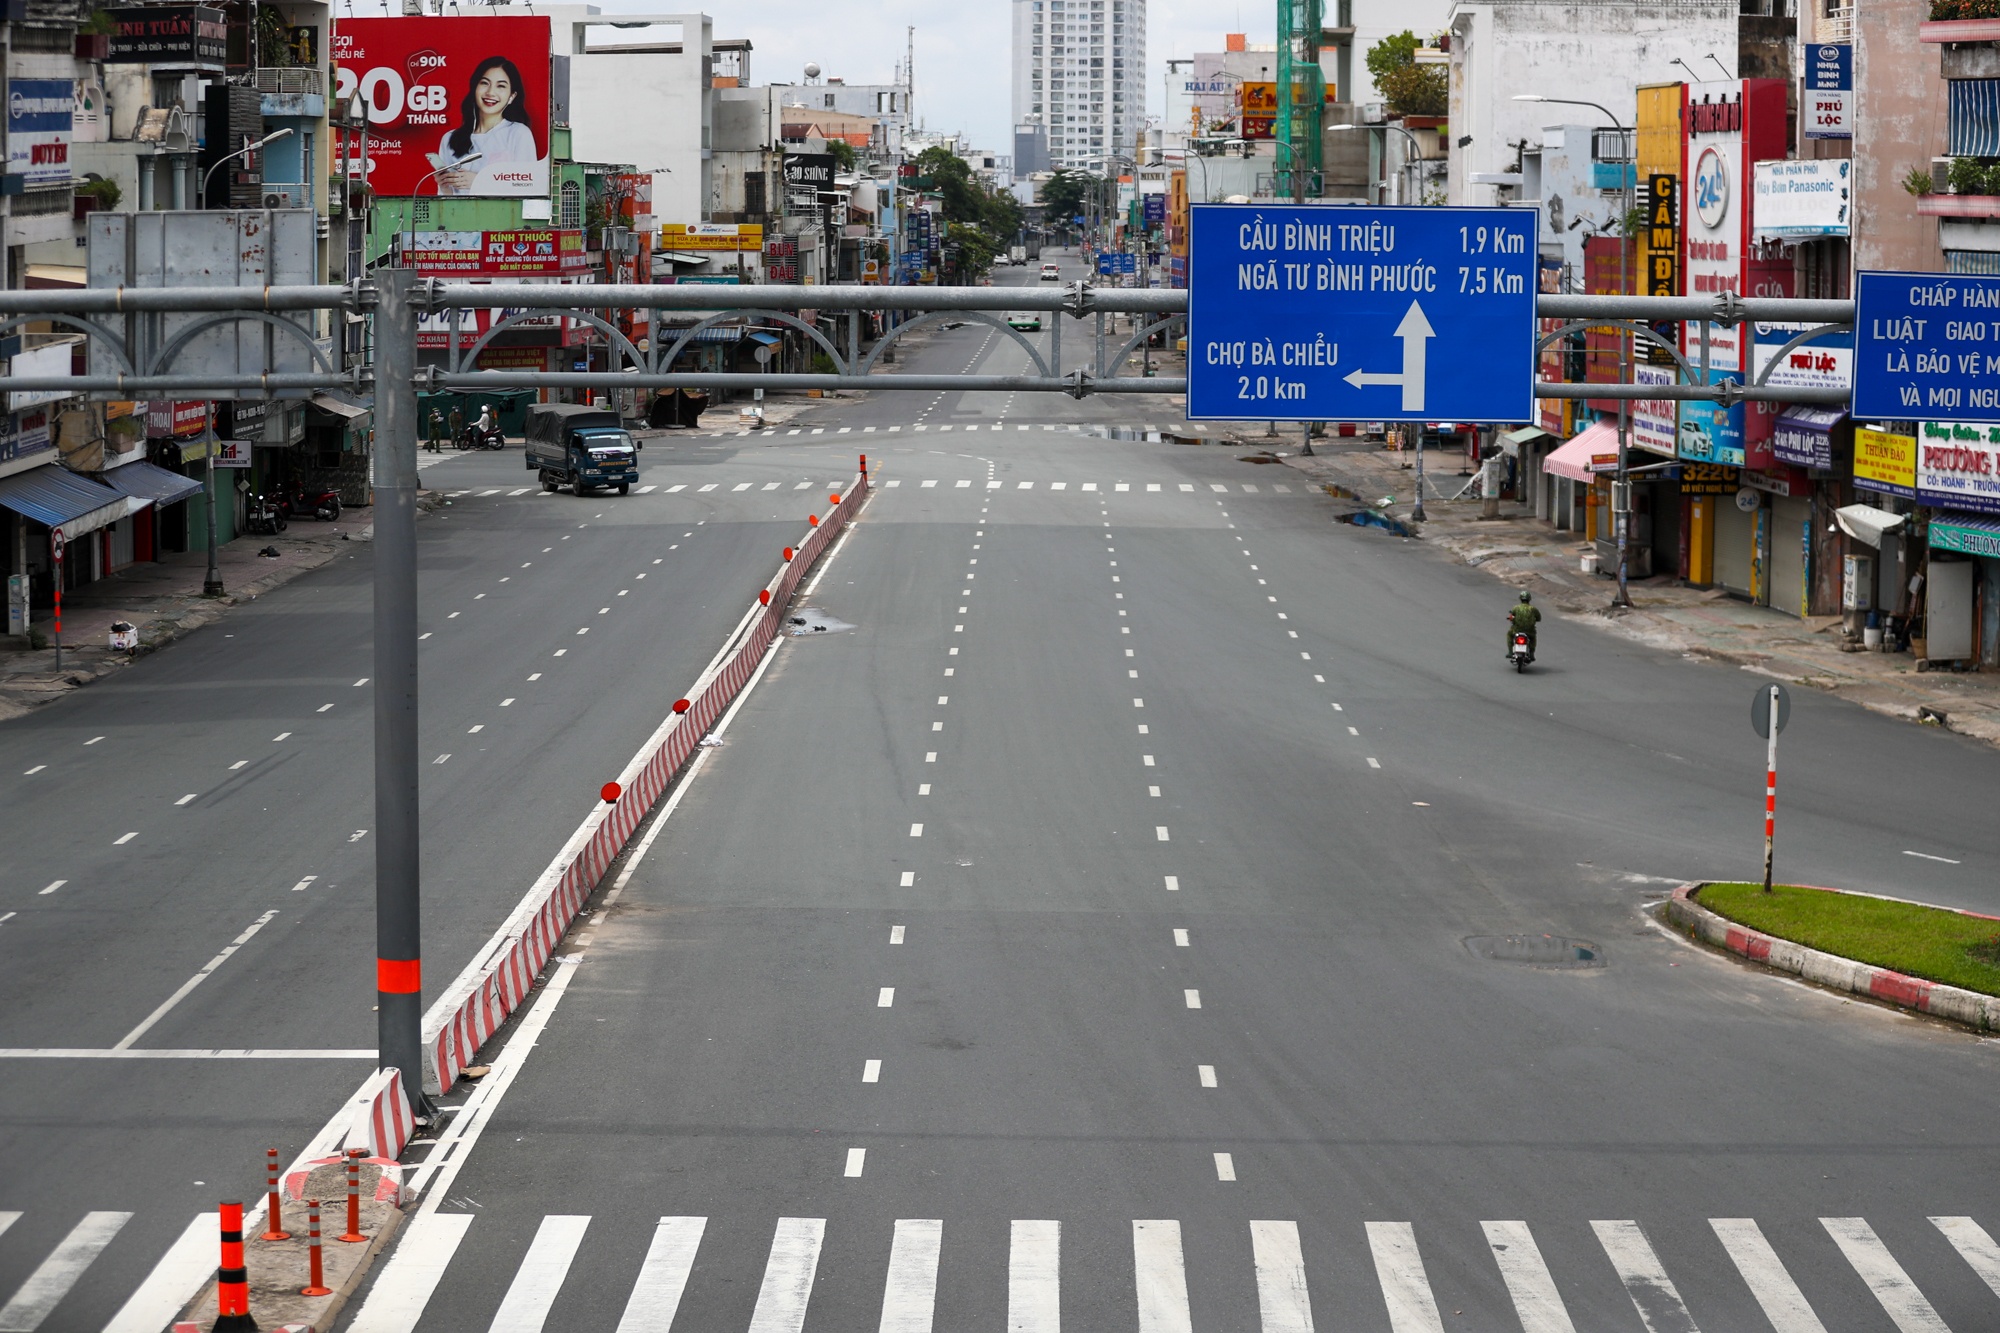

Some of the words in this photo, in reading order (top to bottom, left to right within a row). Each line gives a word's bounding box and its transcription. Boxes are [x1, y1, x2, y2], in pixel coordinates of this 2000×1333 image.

[420, 56, 446, 67] 90K
[407, 85, 448, 112] GB
[1816, 100, 1842, 111] PHÚ
[406, 112, 446, 124] THÁNG
[1817, 113, 1842, 127] LỘC
[381, 140, 402, 150] phút
[493, 172, 533, 181] viettel
[1789, 178, 1834, 192] Panasonic
[490, 232, 515, 242] KÍNH
[518, 230, 553, 242] THUỐC
[1240, 214, 1278, 251] CẦU
[1285, 218, 1331, 251] BÌNH
[1339, 220, 1395, 257] TRIỆU
[1459, 226, 1487, 255] 1,9
[1494, 228, 1525, 254] Km
[1238, 260, 1278, 290] NGÃ
[1284, 263, 1310, 290] TƯ
[1317, 258, 1363, 291] BÌNH
[1371, 258, 1437, 292] PHƯỚC
[1459, 267, 1486, 296] 7,5
[1494, 268, 1524, 294] Km
[1910, 281, 1957, 306] CHẤP
[1963, 283, 2000, 308] HÀN
[1873, 316, 1927, 344] LUẬT
[1946, 321, 1985, 341] GIAO
[1207, 341, 1245, 369] CHỢ
[1252, 337, 1276, 366] BÀ
[1282, 332, 1338, 366] CHIỂU
[1815, 352, 1836, 374] LỘC
[1887, 348, 1910, 372] LÀ
[1916, 348, 1950, 373] BẢO
[1958, 352, 1980, 378] VỆ
[1238, 376, 1268, 401] 2,0
[1274, 377, 1306, 399] km
[1900, 382, 1921, 406] VÀ
[1928, 388, 1961, 411] MỌI
[150, 412, 170, 432] THOẠI
[1683, 463, 1737, 481] 322C
[1692, 483, 1704, 493] VIẾT
[1941, 475, 1966, 488] HOÀNH
[1741, 494, 1758, 507] 24h
